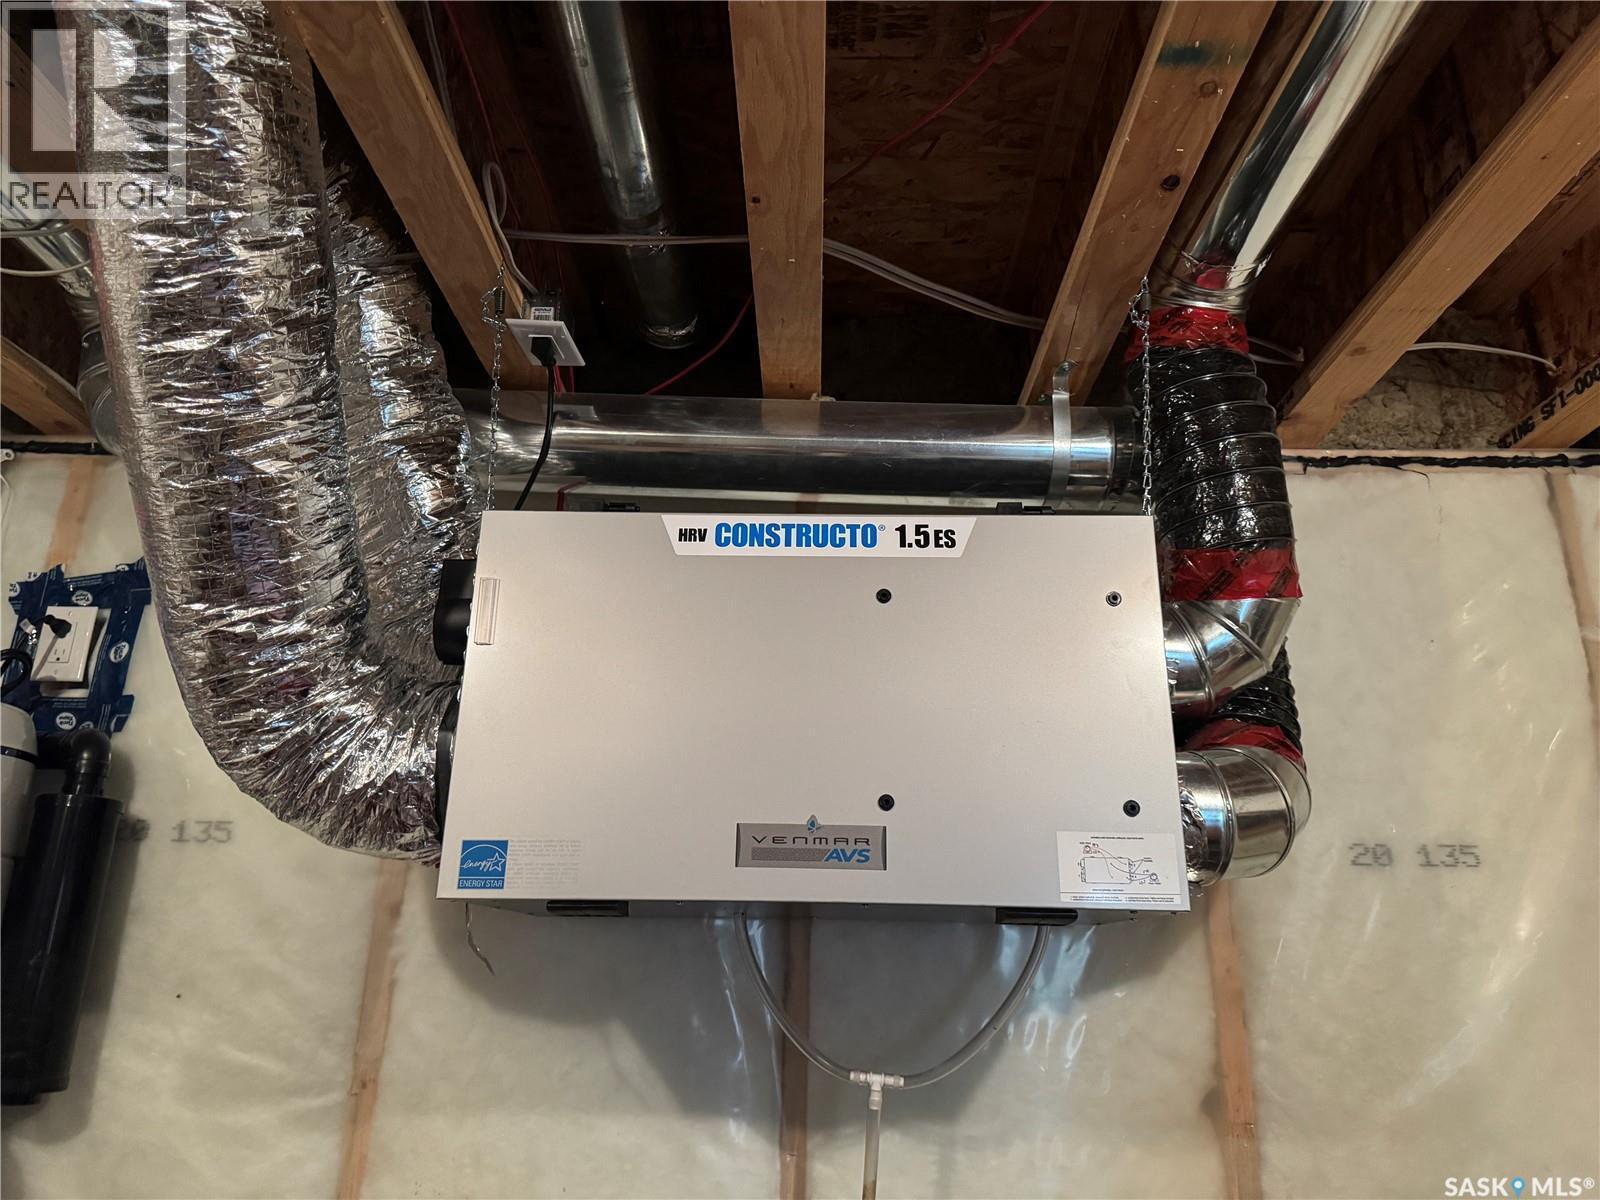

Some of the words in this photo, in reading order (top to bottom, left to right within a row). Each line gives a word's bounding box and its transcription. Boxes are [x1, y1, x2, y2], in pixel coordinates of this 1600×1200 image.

[678, 527, 708, 543] HRV
[894, 523, 930, 549] 1.5
[934, 529, 957, 549] ES
[170, 820, 234, 843] 135
[752, 835, 871, 846] VENMAR
[823, 848, 871, 864] AVS
[1416, 843, 1482, 868] 135
[459, 879, 486, 888] ENERGY
[486, 879, 503, 888] STAR
